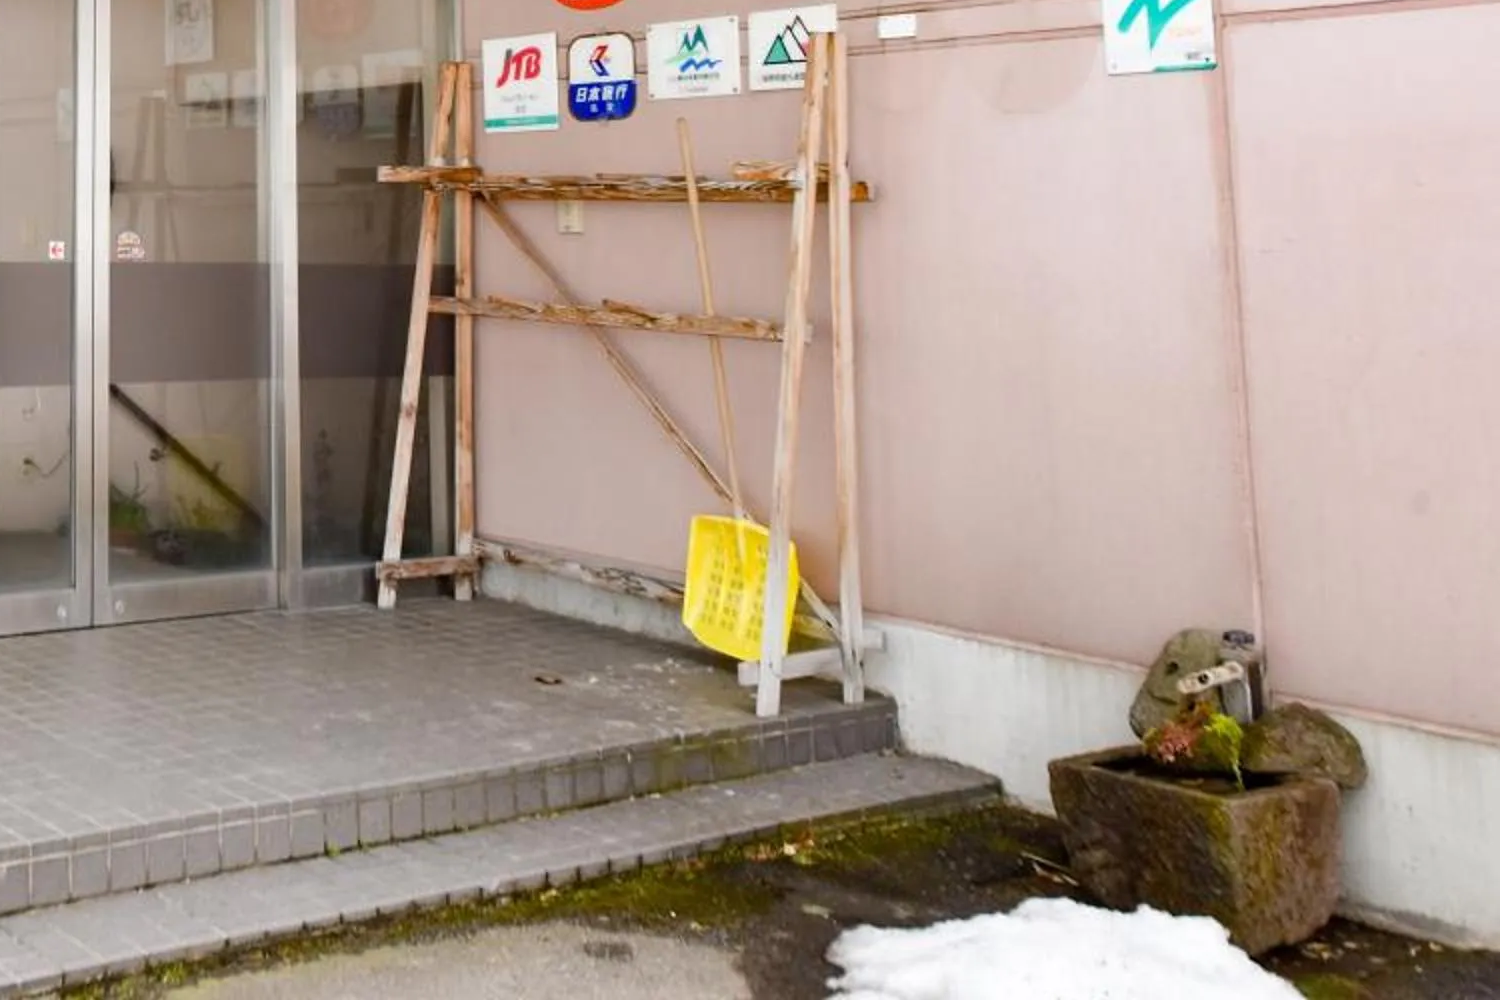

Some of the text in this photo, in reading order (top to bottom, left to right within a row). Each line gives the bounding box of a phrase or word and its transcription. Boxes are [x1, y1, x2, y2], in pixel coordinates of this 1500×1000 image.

[496, 46, 542, 89] JTB
[575, 83, 629, 103] 日本旅行
